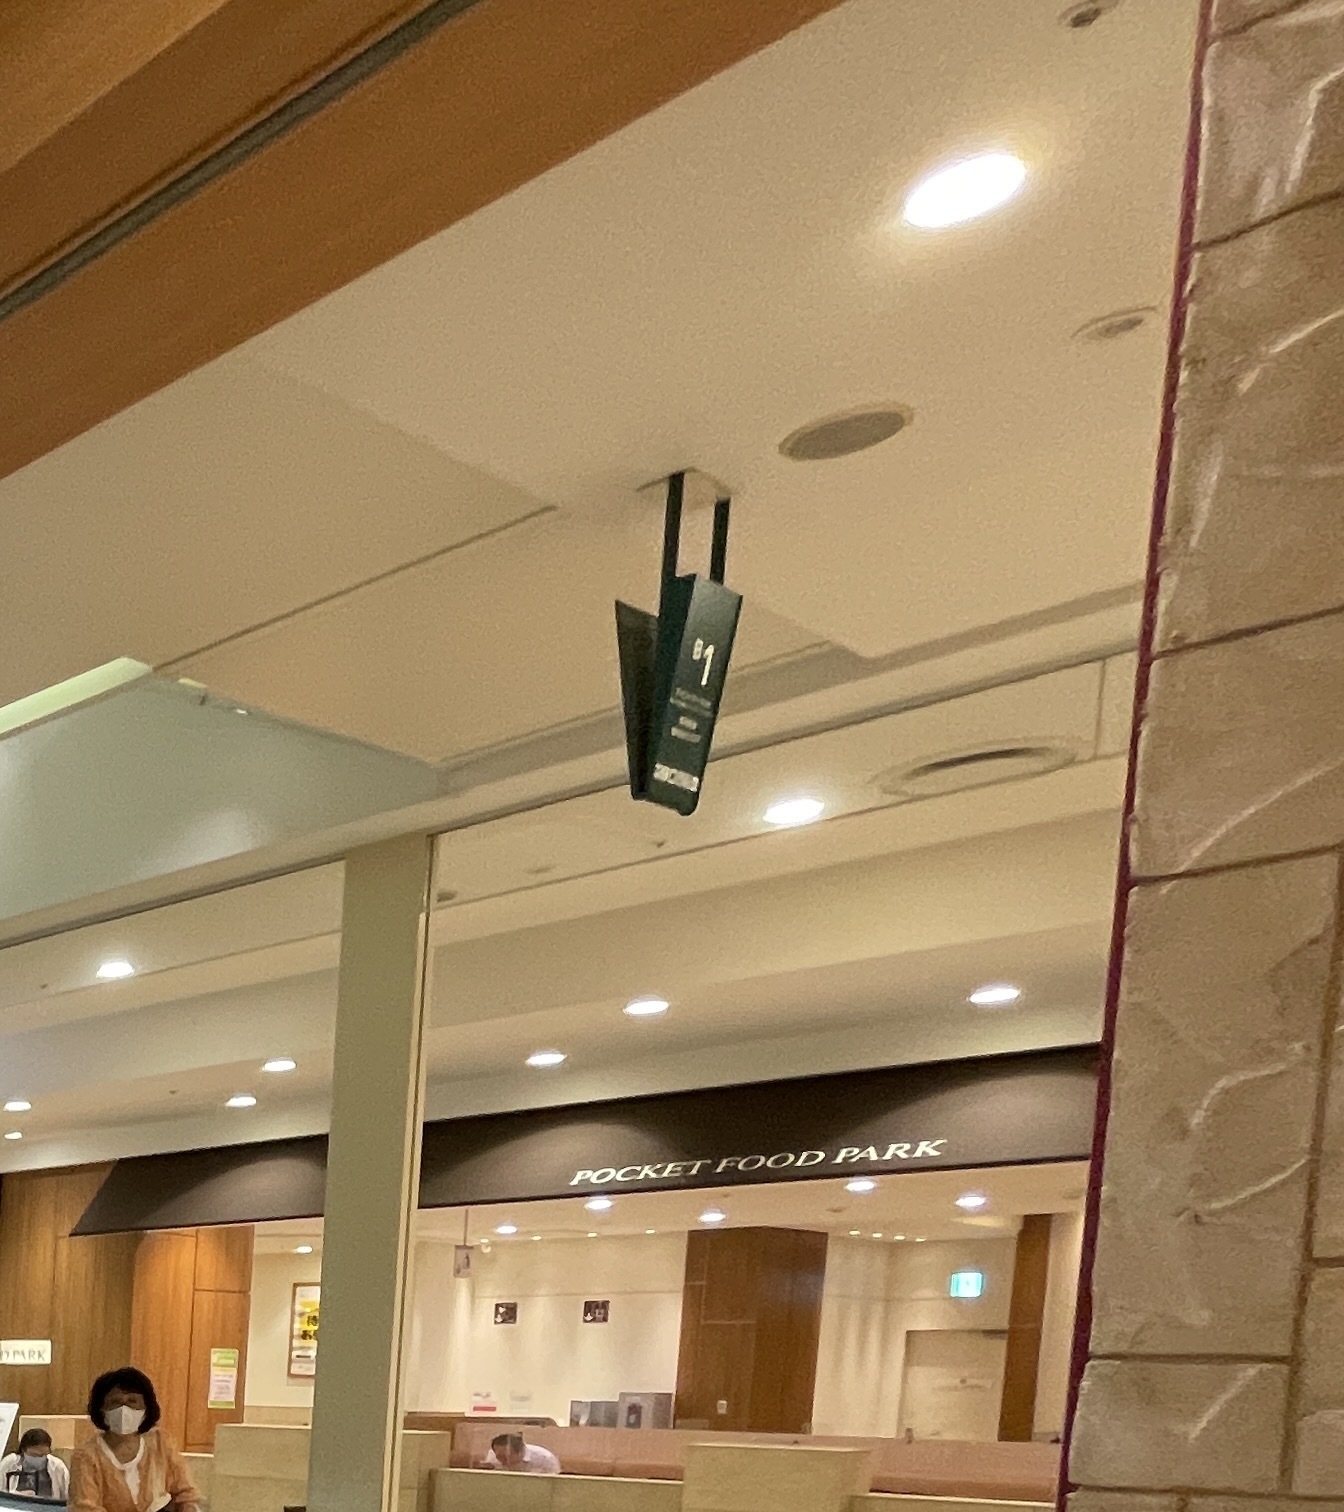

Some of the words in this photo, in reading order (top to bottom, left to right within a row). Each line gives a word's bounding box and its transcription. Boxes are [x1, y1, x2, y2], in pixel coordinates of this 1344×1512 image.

[569, 1159, 712, 1186] POCKET
[714, 1150, 826, 1173] FOOD
[831, 1139, 948, 1165] PARK
[12, 1349, 46, 1362] PARK
